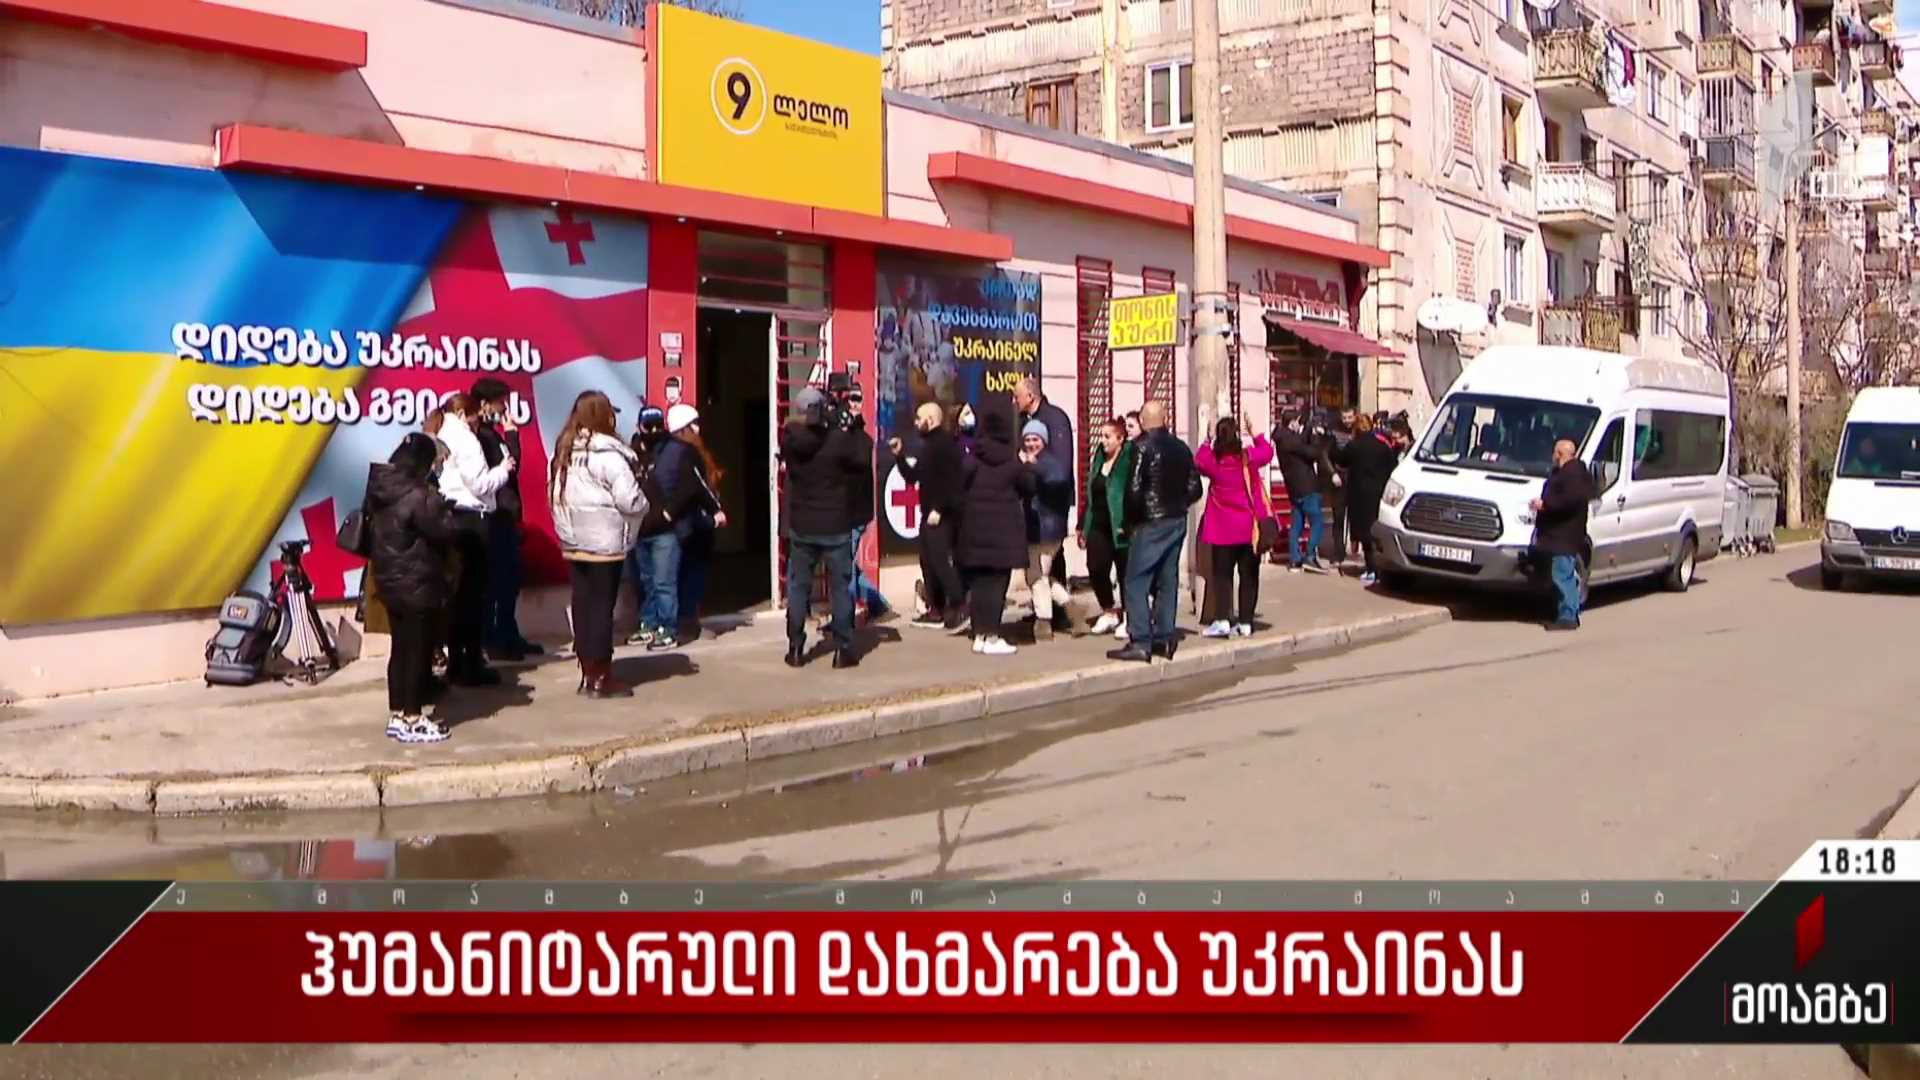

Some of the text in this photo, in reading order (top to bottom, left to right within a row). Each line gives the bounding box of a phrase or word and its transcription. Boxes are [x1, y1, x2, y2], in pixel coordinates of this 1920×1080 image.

[727, 72, 751, 120] 9
[773, 94, 849, 130] ლელო
[1114, 298, 1175, 323] თონის
[172, 322, 542, 373] დიდება უკრაინას
[1114, 320, 1173, 346] პური
[953, 336, 1038, 362] უკრაინელ
[986, 371, 1032, 392] ხალ
[187, 384, 361, 425] დიდება
